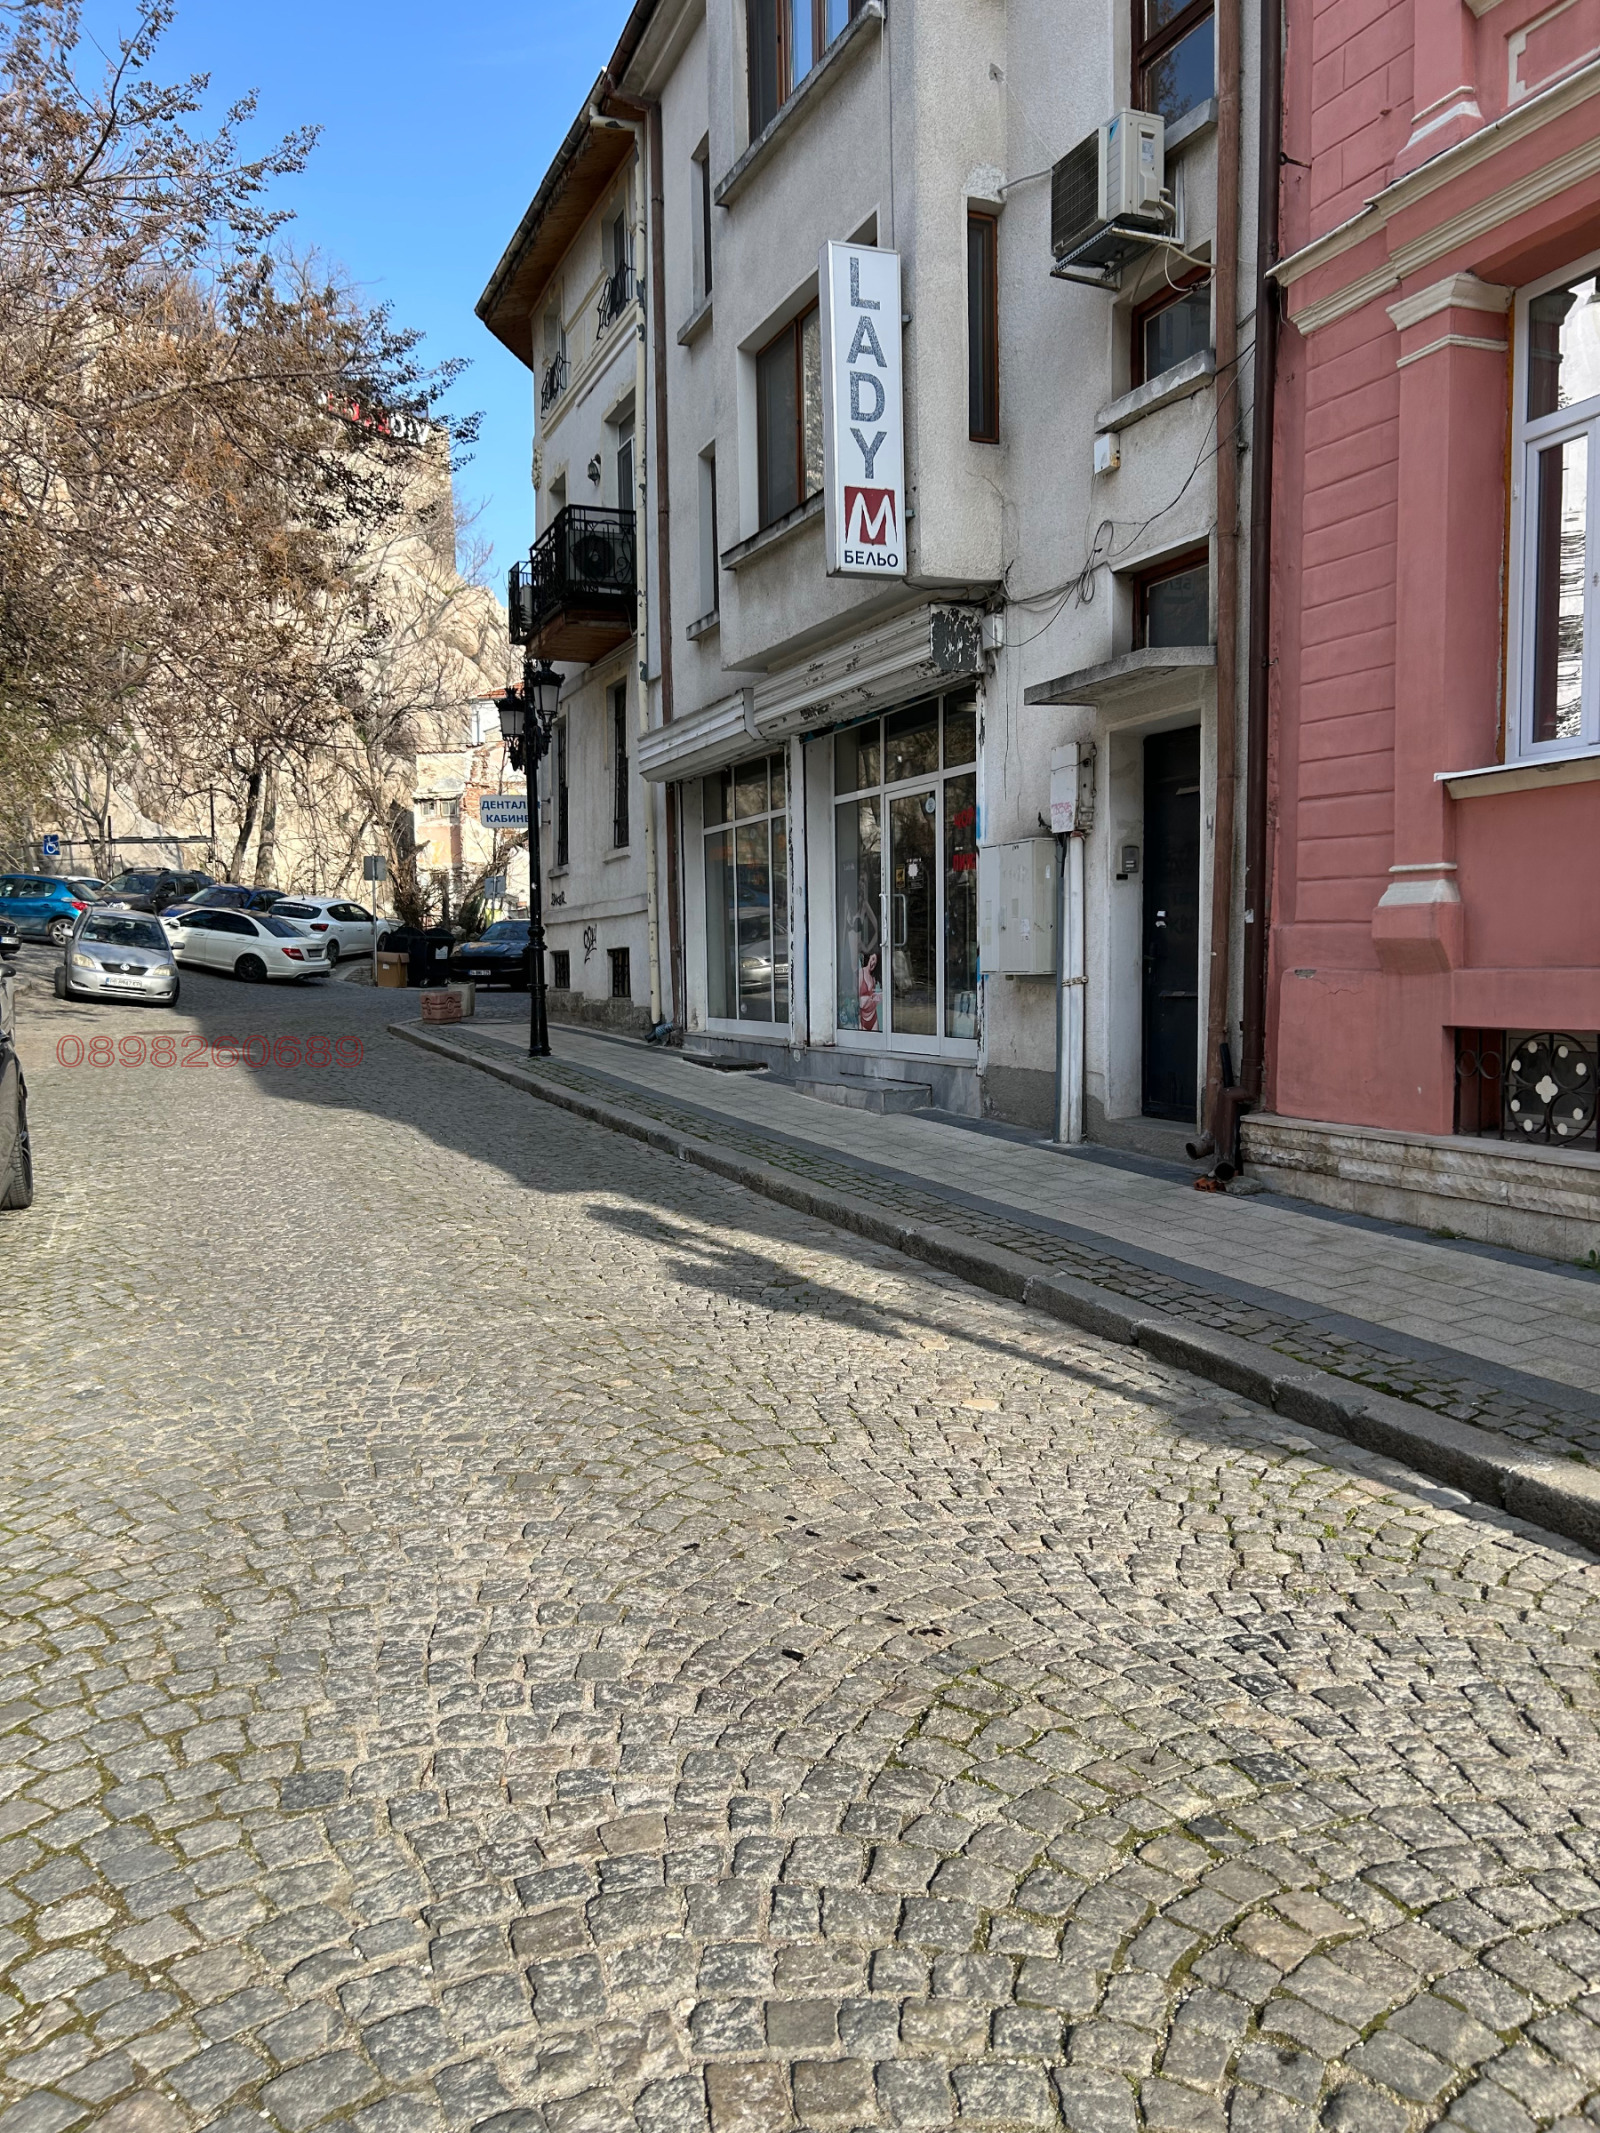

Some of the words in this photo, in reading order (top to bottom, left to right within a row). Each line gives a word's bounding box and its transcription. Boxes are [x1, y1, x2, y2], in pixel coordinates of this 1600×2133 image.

[846, 257, 887, 479] LADY
[845, 491, 897, 546] M
[844, 550, 899, 568] БЕЛЬО
[481, 800, 541, 811] ДЕНТАЛ
